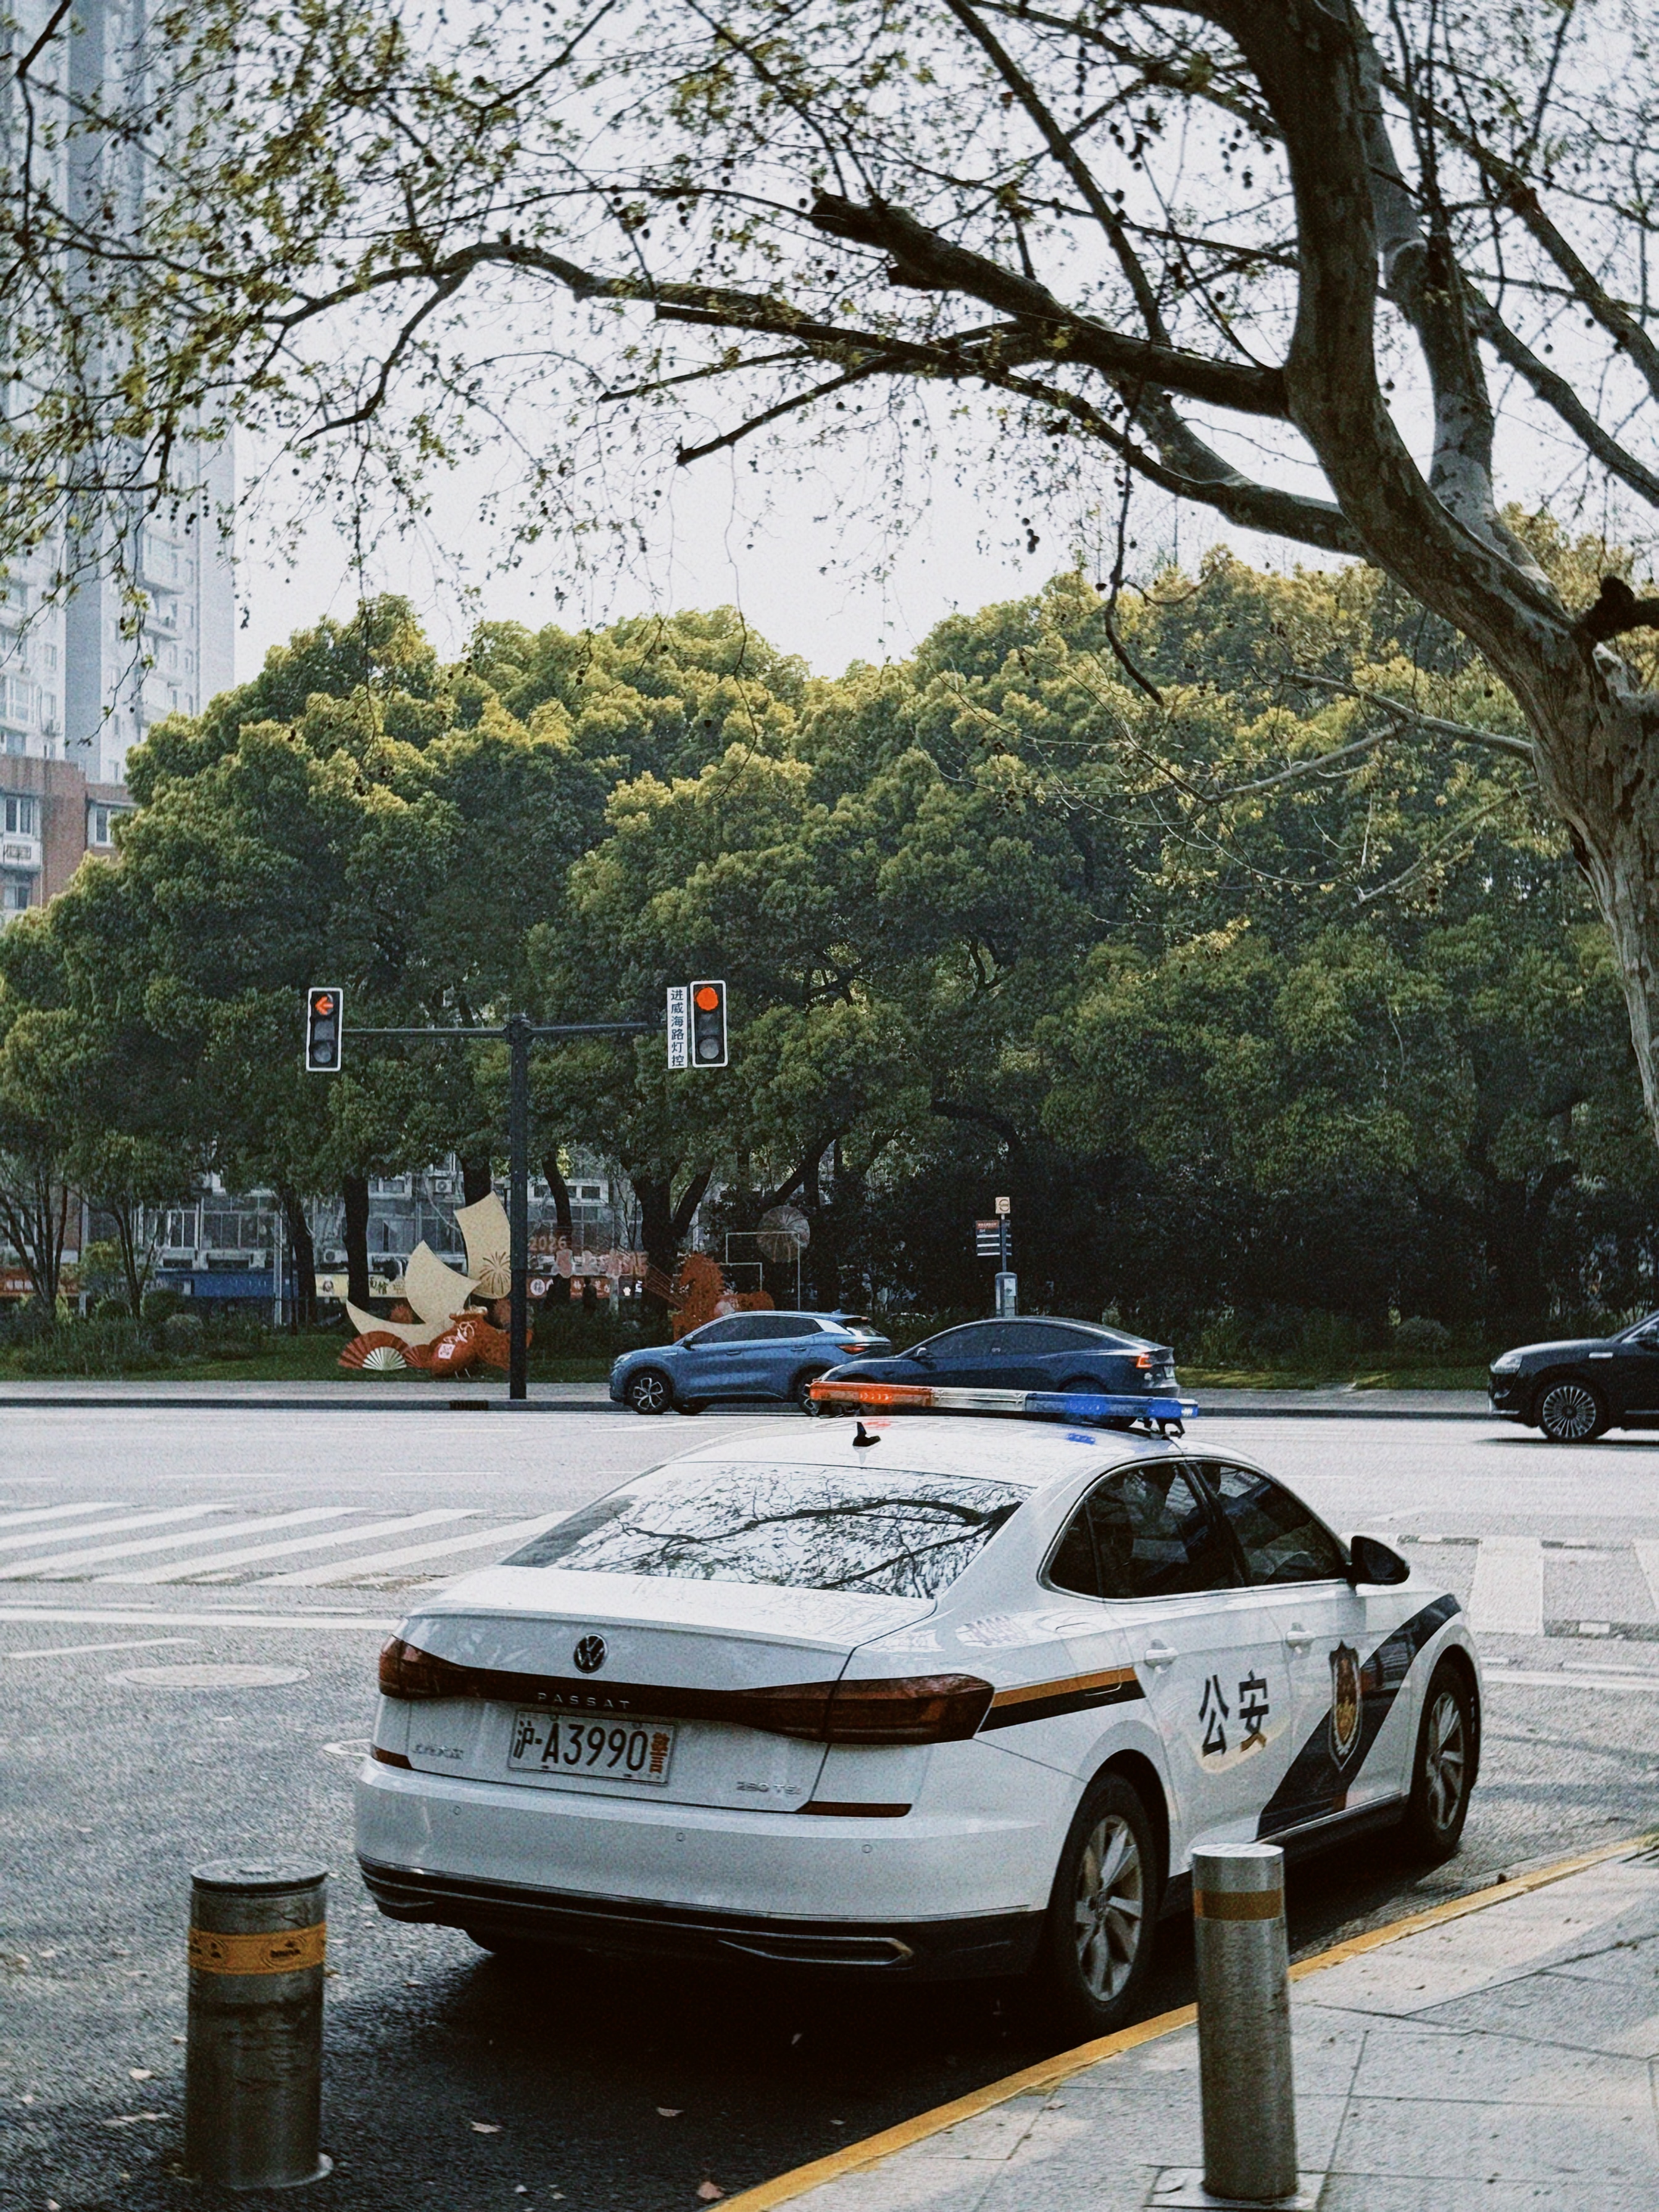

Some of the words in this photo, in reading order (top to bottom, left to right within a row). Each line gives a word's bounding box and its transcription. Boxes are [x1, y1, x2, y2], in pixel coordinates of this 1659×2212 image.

[670, 989, 684, 1067] 进威海路灯控
[528, 1235, 567, 1252] 2026
[537, 1692, 630, 1710] PASSAT
[1198, 1668, 1270, 1757] 公安
